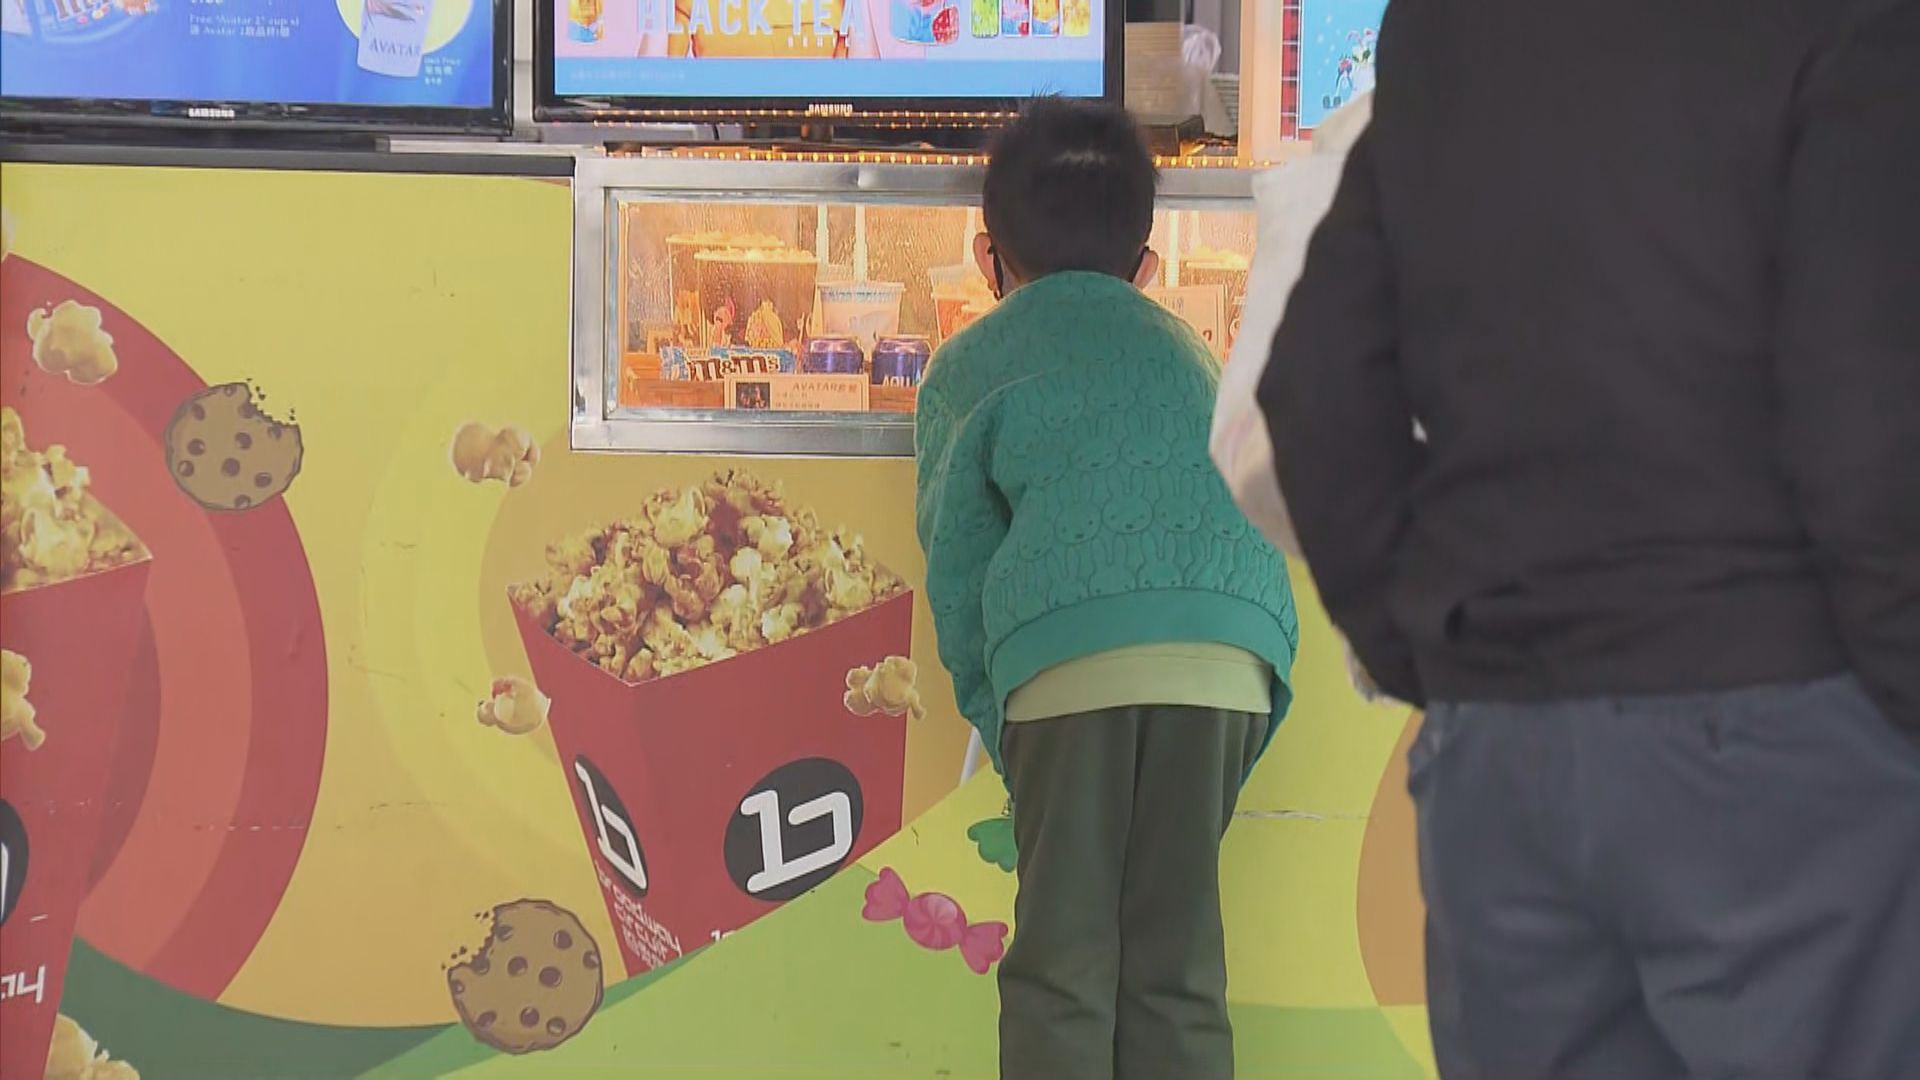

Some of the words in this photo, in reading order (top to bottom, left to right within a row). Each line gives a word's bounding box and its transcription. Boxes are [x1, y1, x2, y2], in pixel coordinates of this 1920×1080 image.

[636, 0, 773, 36] BLACK
[790, 0, 866, 36] TEA
[368, 38, 421, 57] AVATAR
[188, 107, 235, 118] SAMSUNG
[808, 103, 853, 114] SAMSUNG
